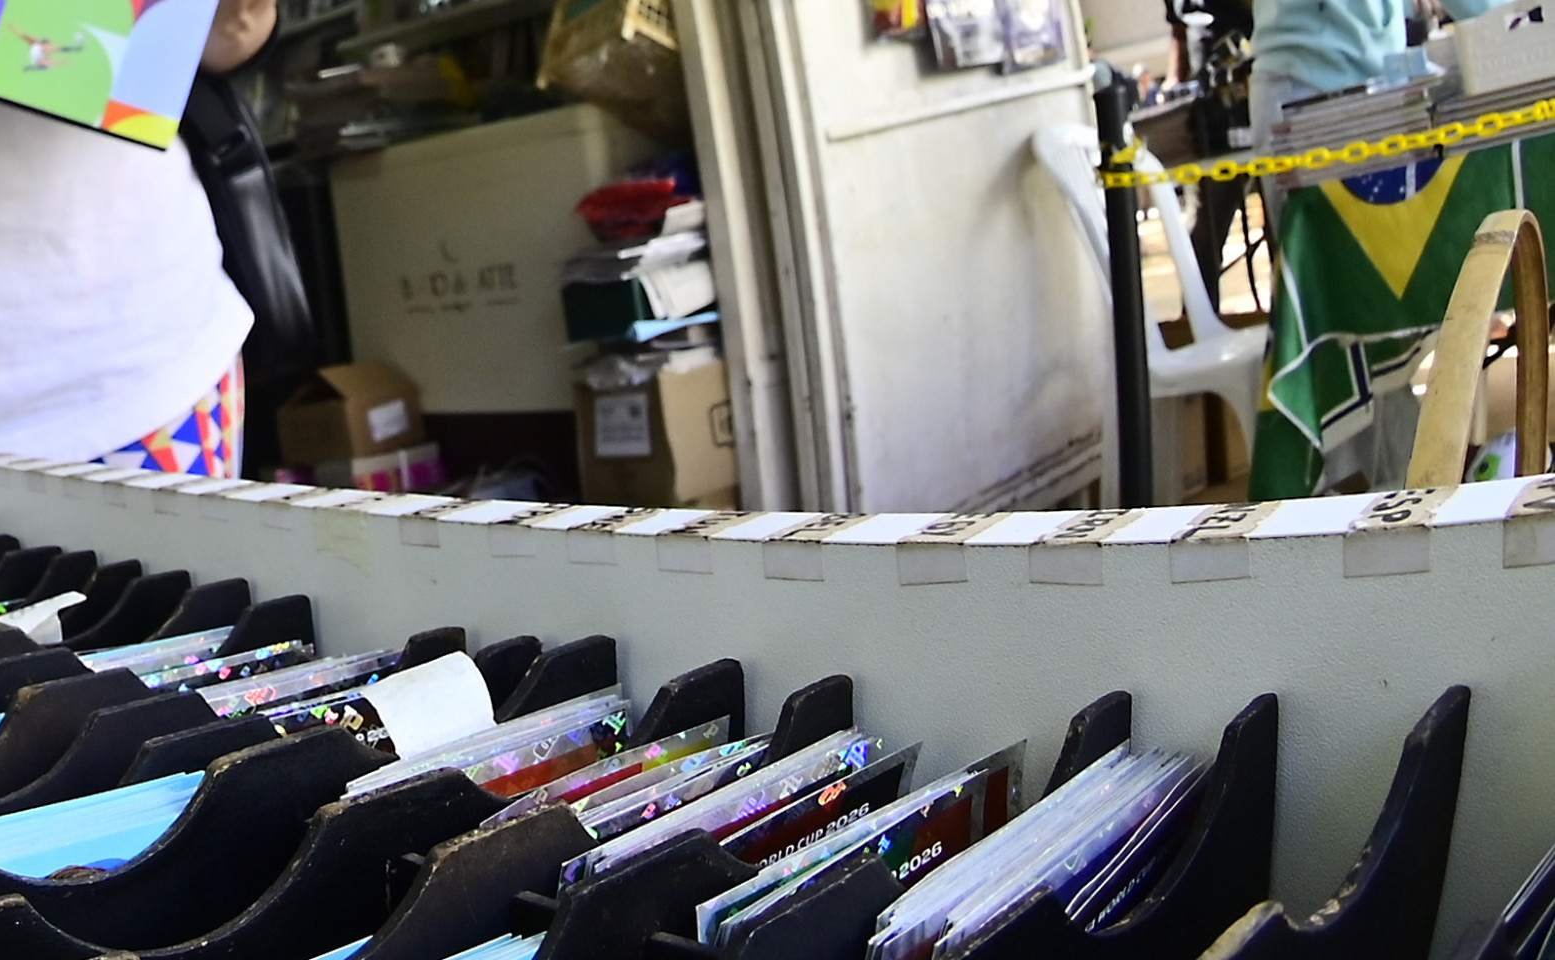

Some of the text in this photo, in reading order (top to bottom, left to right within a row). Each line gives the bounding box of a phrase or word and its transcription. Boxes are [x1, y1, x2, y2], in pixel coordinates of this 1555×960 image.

[755, 803, 870, 869] ORLD CUP 2026
[898, 841, 943, 881] 2026
